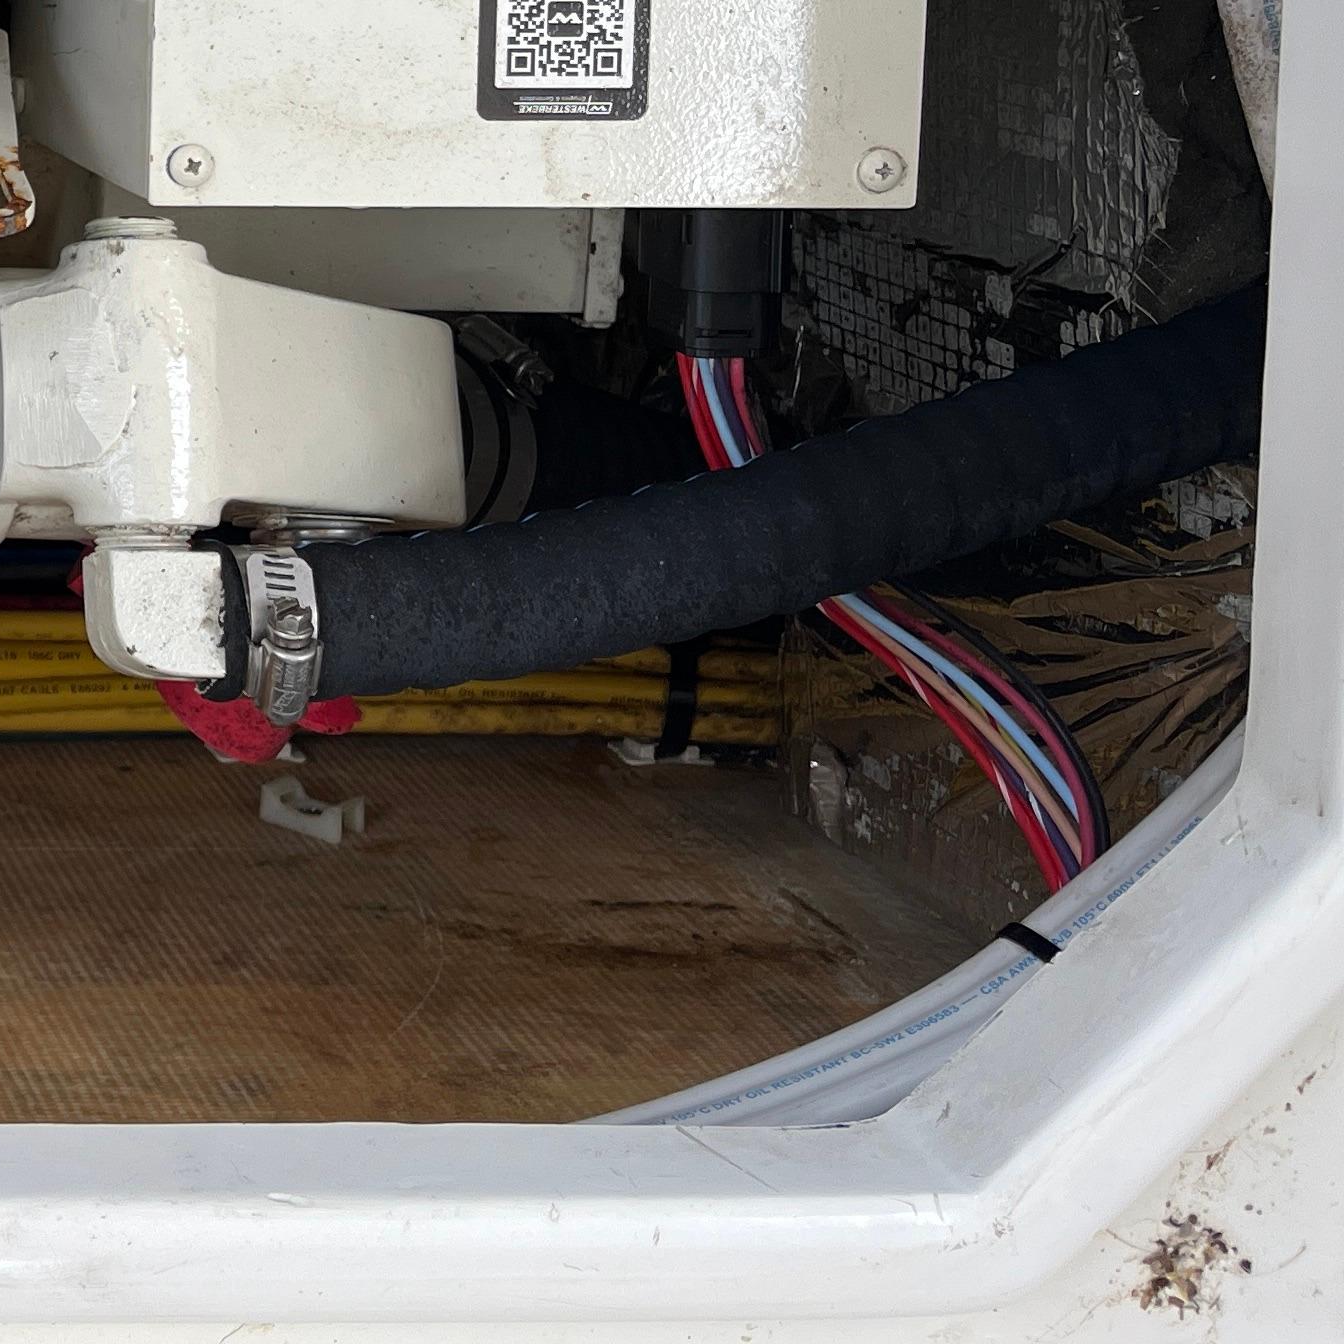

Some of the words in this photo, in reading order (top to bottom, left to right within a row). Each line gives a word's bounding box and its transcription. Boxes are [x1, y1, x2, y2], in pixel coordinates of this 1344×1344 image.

[518, 105, 586, 113] WESTERBEKE
[711, 1094, 742, 1112] DRY
[745, 1086, 769, 1100] OIL
[771, 1055, 849, 1091] RESISTANT
